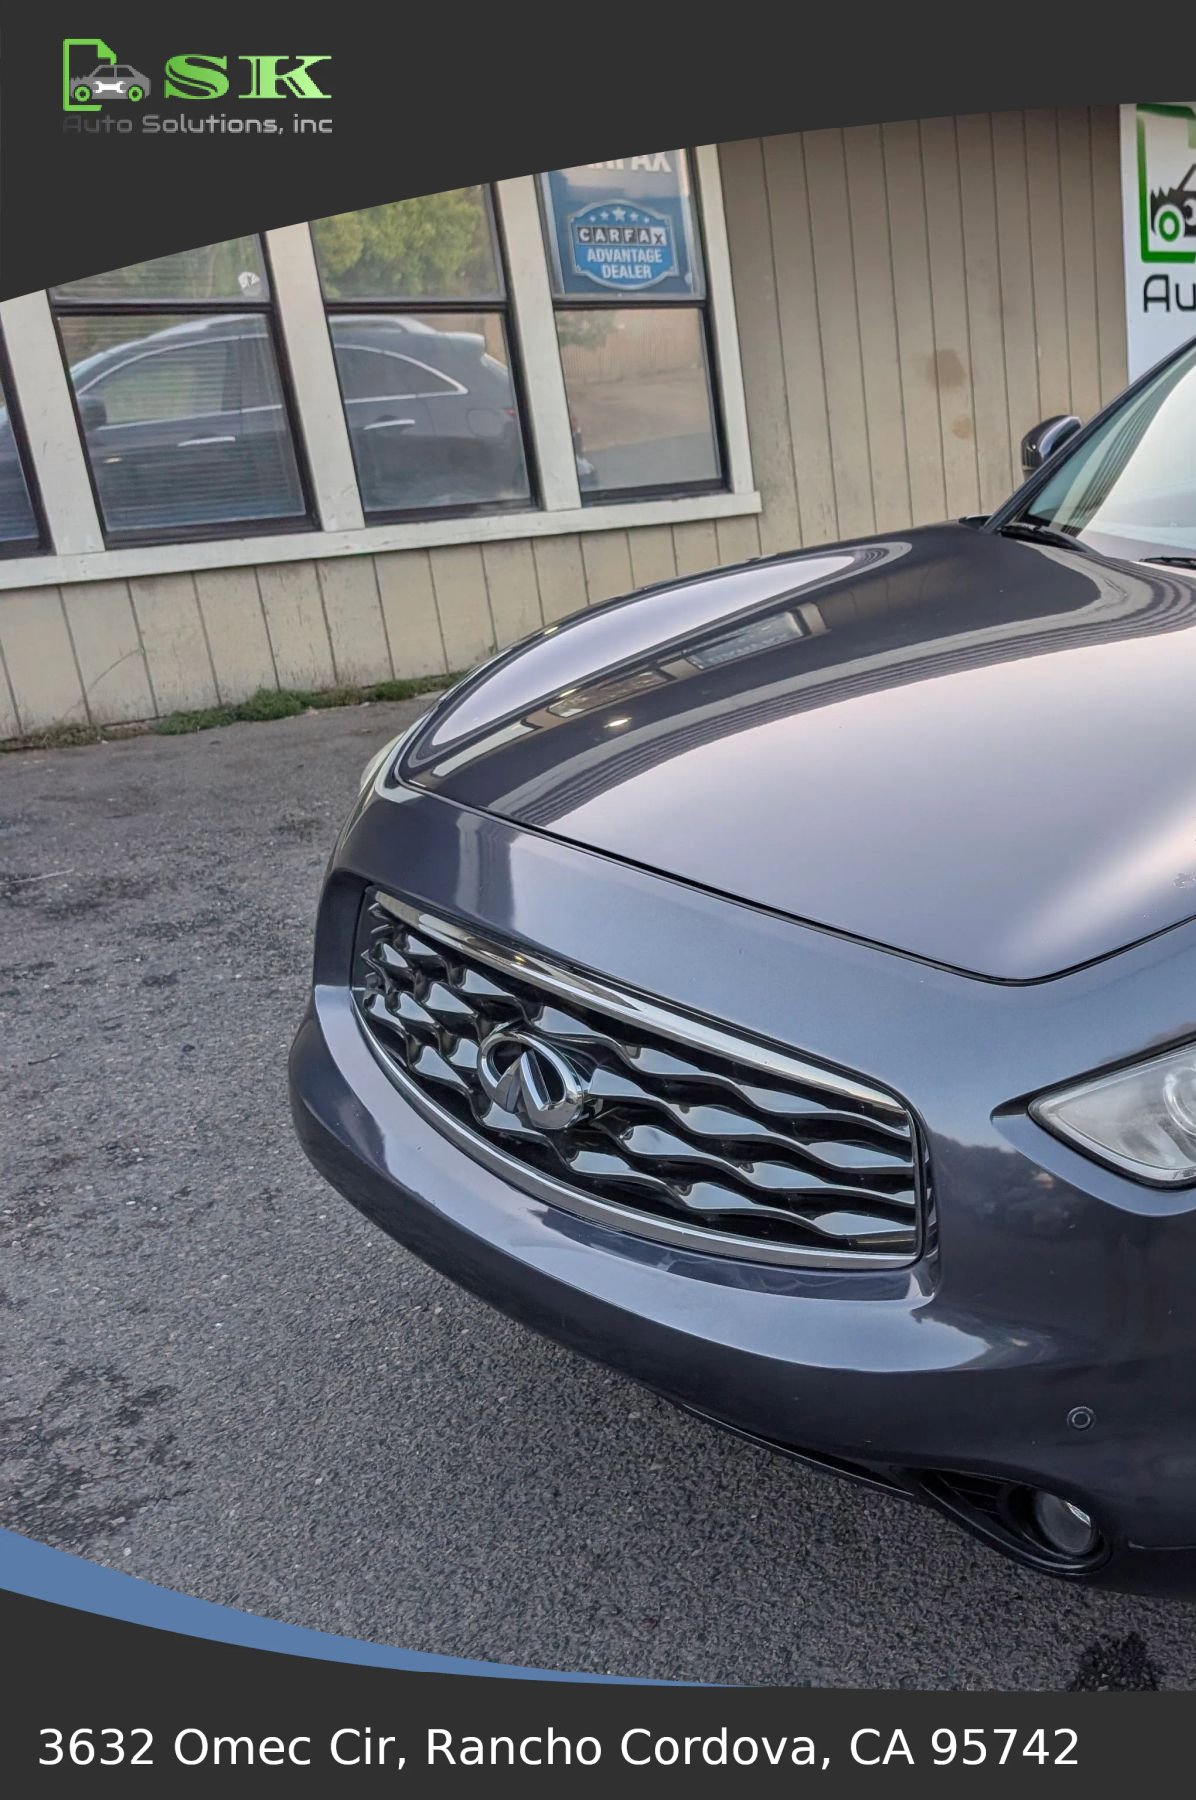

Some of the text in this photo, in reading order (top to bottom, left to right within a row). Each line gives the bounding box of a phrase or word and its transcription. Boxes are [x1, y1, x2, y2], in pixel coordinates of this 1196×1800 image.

[578, 227, 665, 245] CARFAX
[587, 248, 663, 264] ADVANTAGE
[602, 264, 652, 280] DEALER
